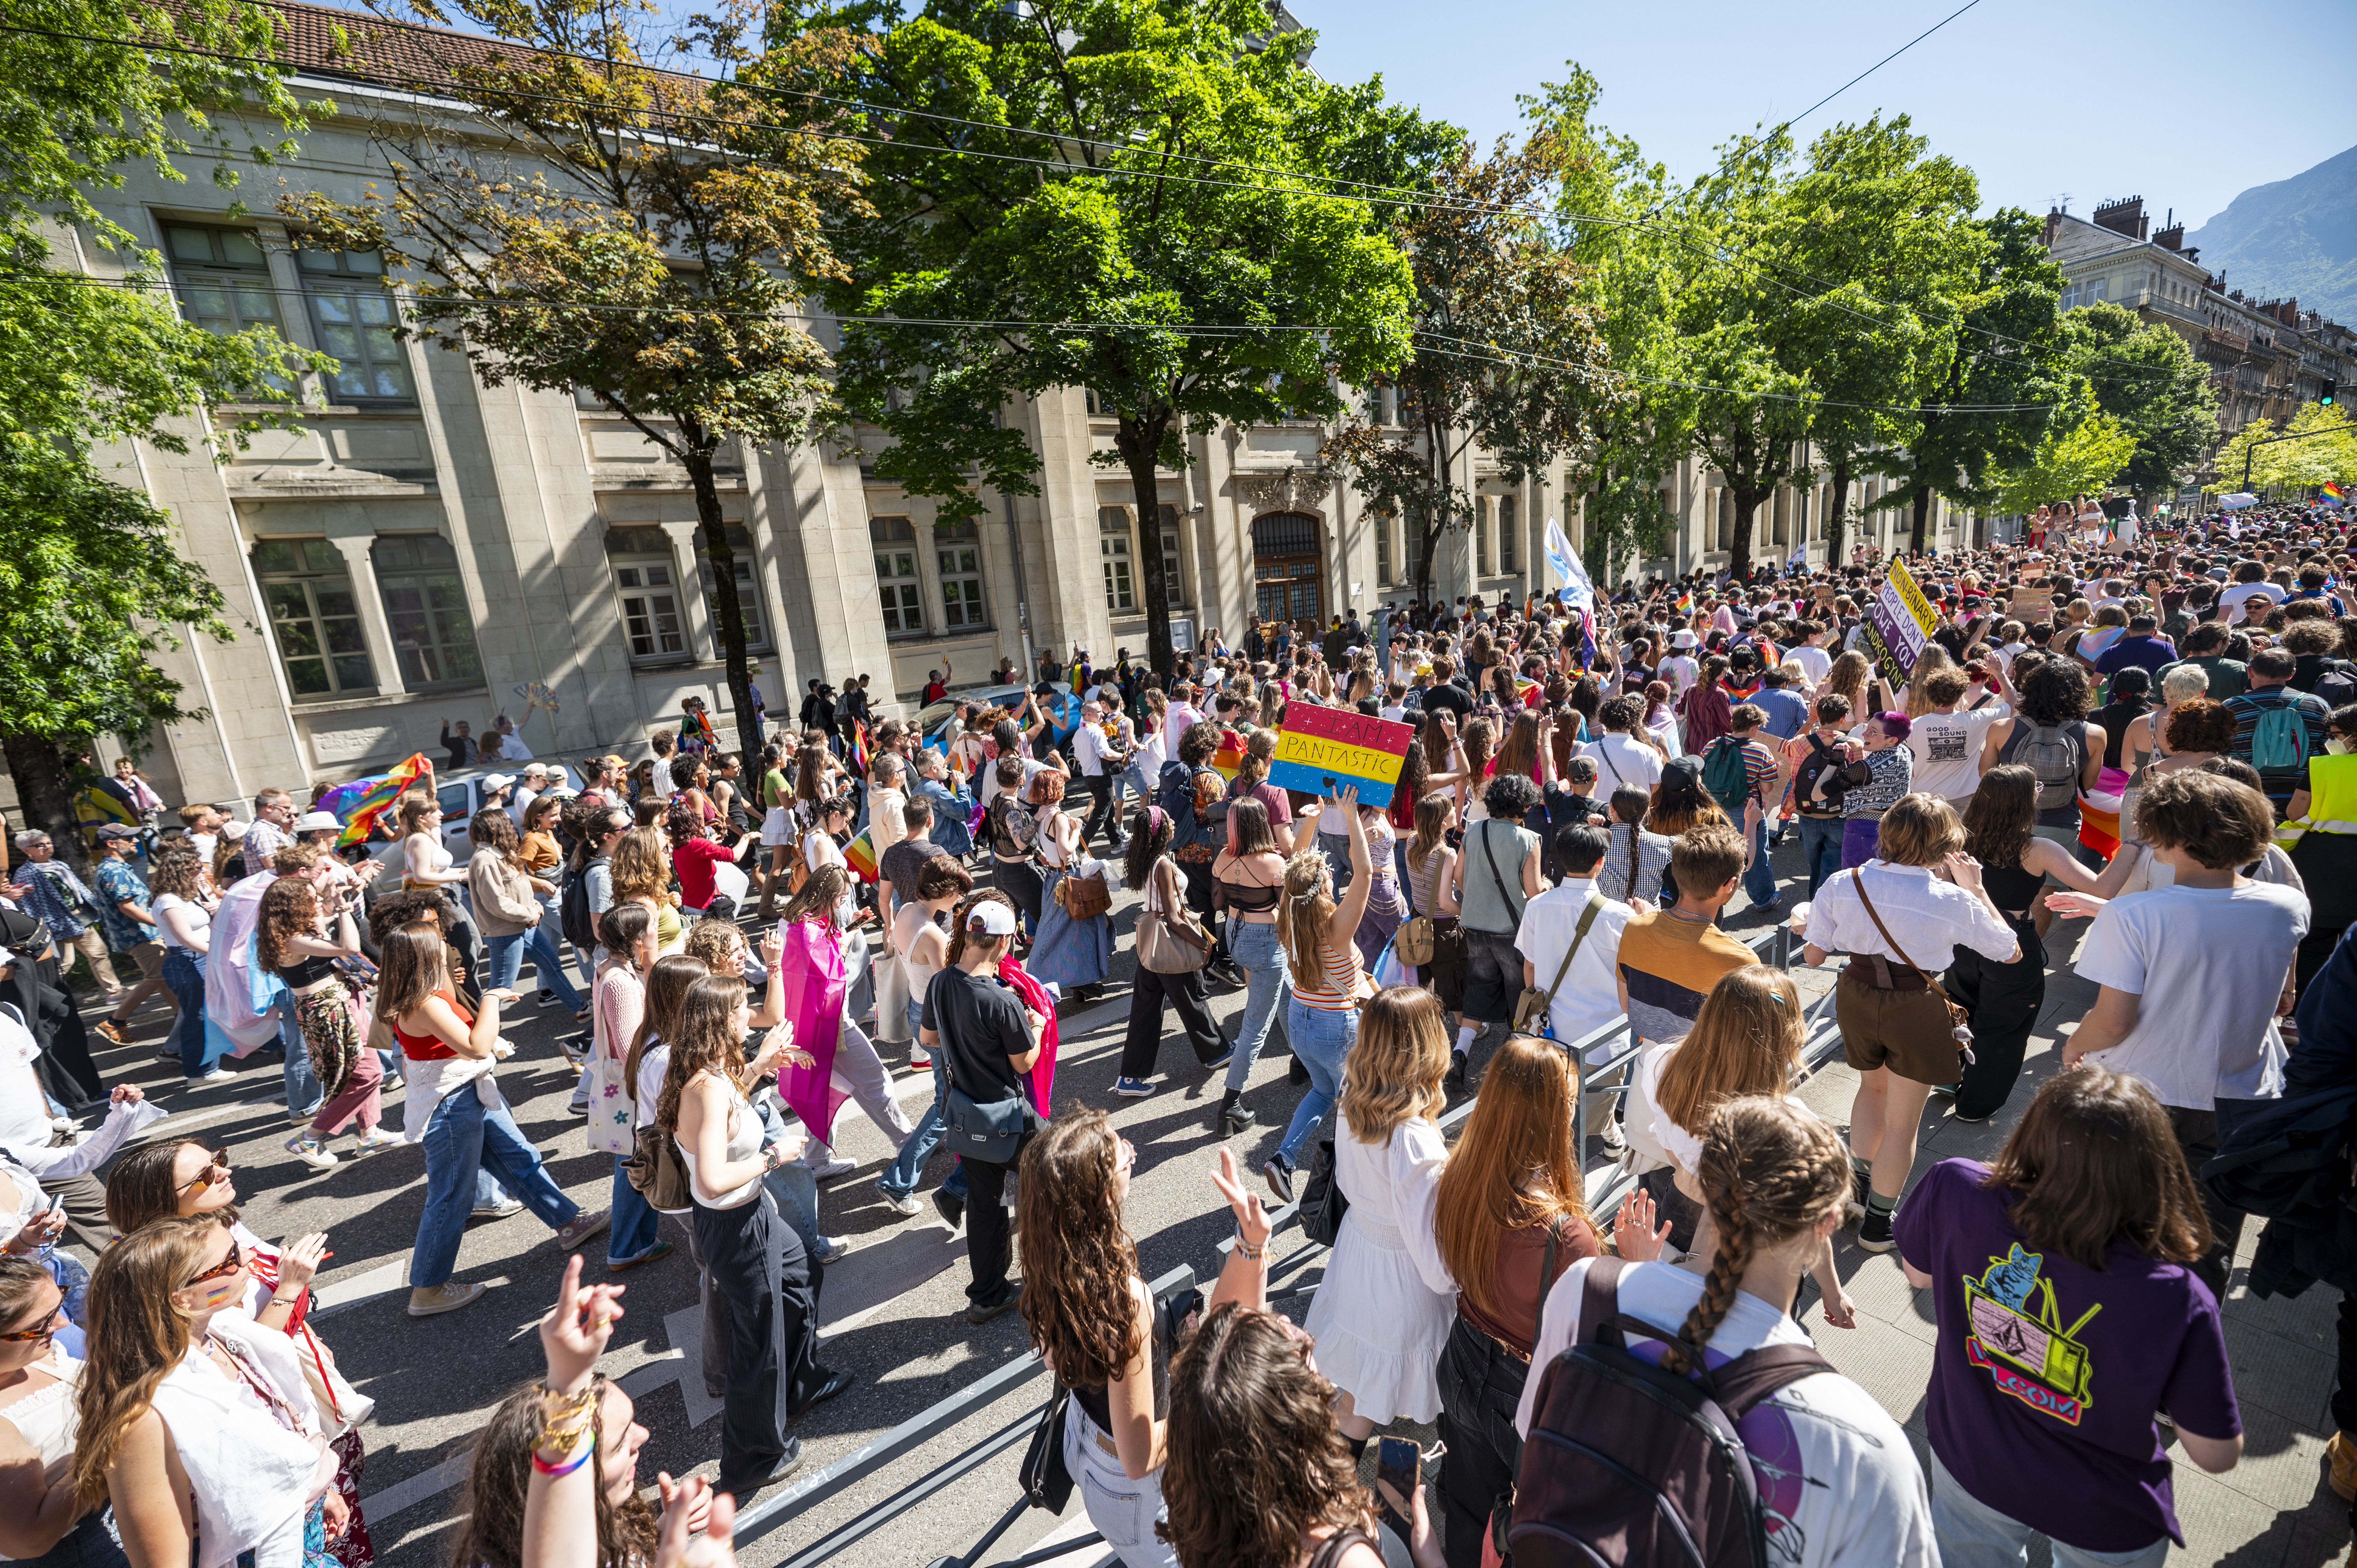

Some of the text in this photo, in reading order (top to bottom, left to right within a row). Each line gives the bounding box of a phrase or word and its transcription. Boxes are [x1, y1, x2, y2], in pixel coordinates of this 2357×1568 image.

[1873, 602, 1914, 669] OWE YOU
[1882, 581, 1925, 651] PEOPLE DON'T
[1863, 620, 1905, 689] ANDROGYNY
[1323, 717, 1383, 743] I AM
